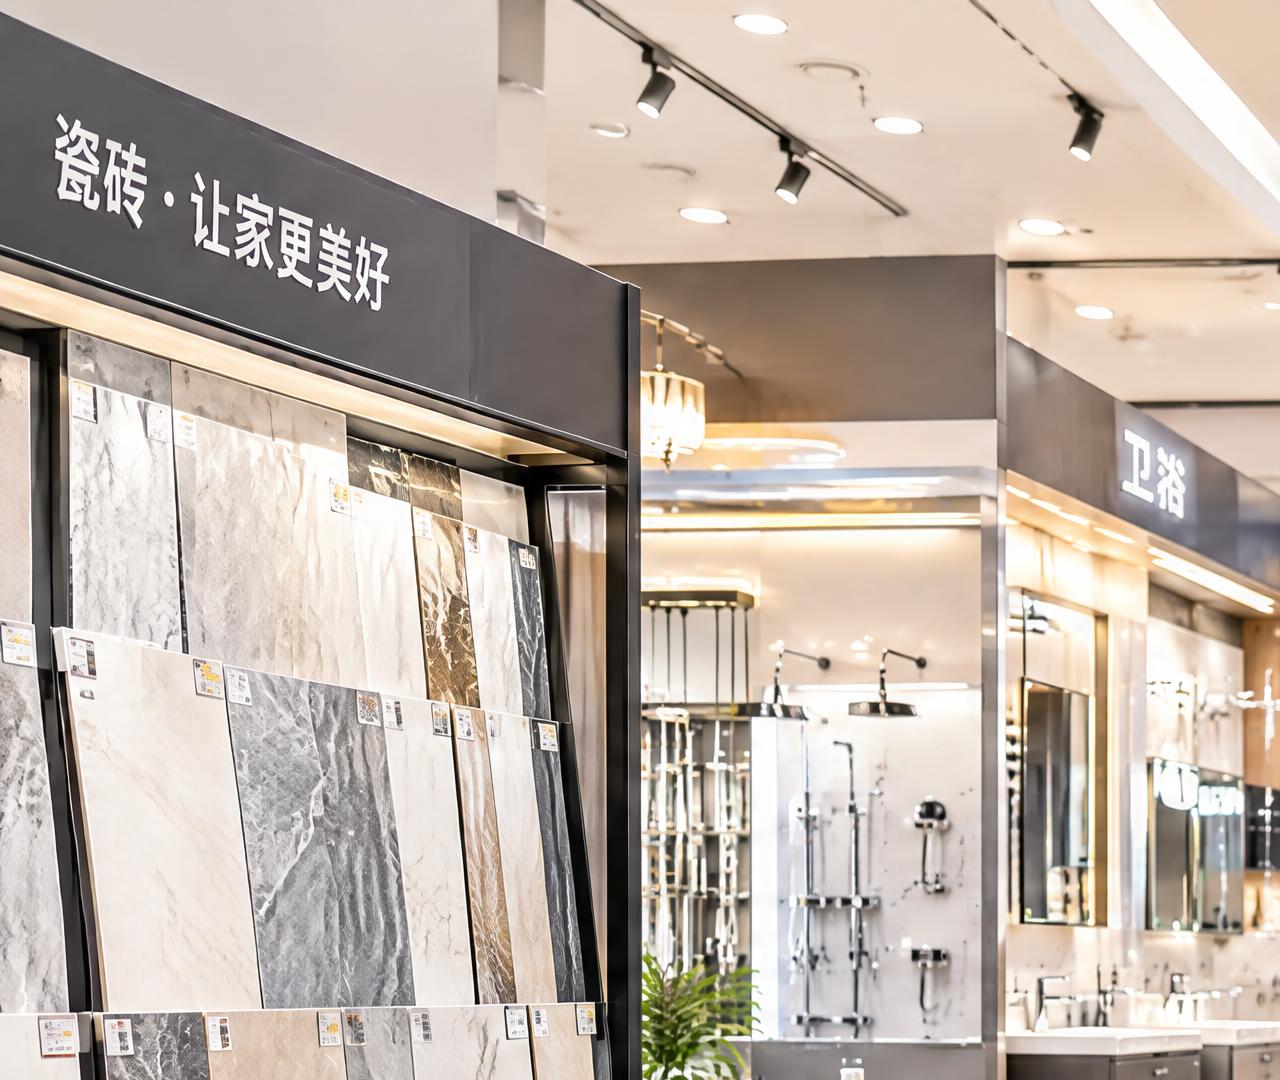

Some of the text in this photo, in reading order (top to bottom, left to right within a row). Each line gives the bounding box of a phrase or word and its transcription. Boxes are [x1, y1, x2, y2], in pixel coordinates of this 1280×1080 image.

[55, 113, 390, 311] 瓷砖·让家更美好
[1122, 428, 1186, 519] 卫浴
